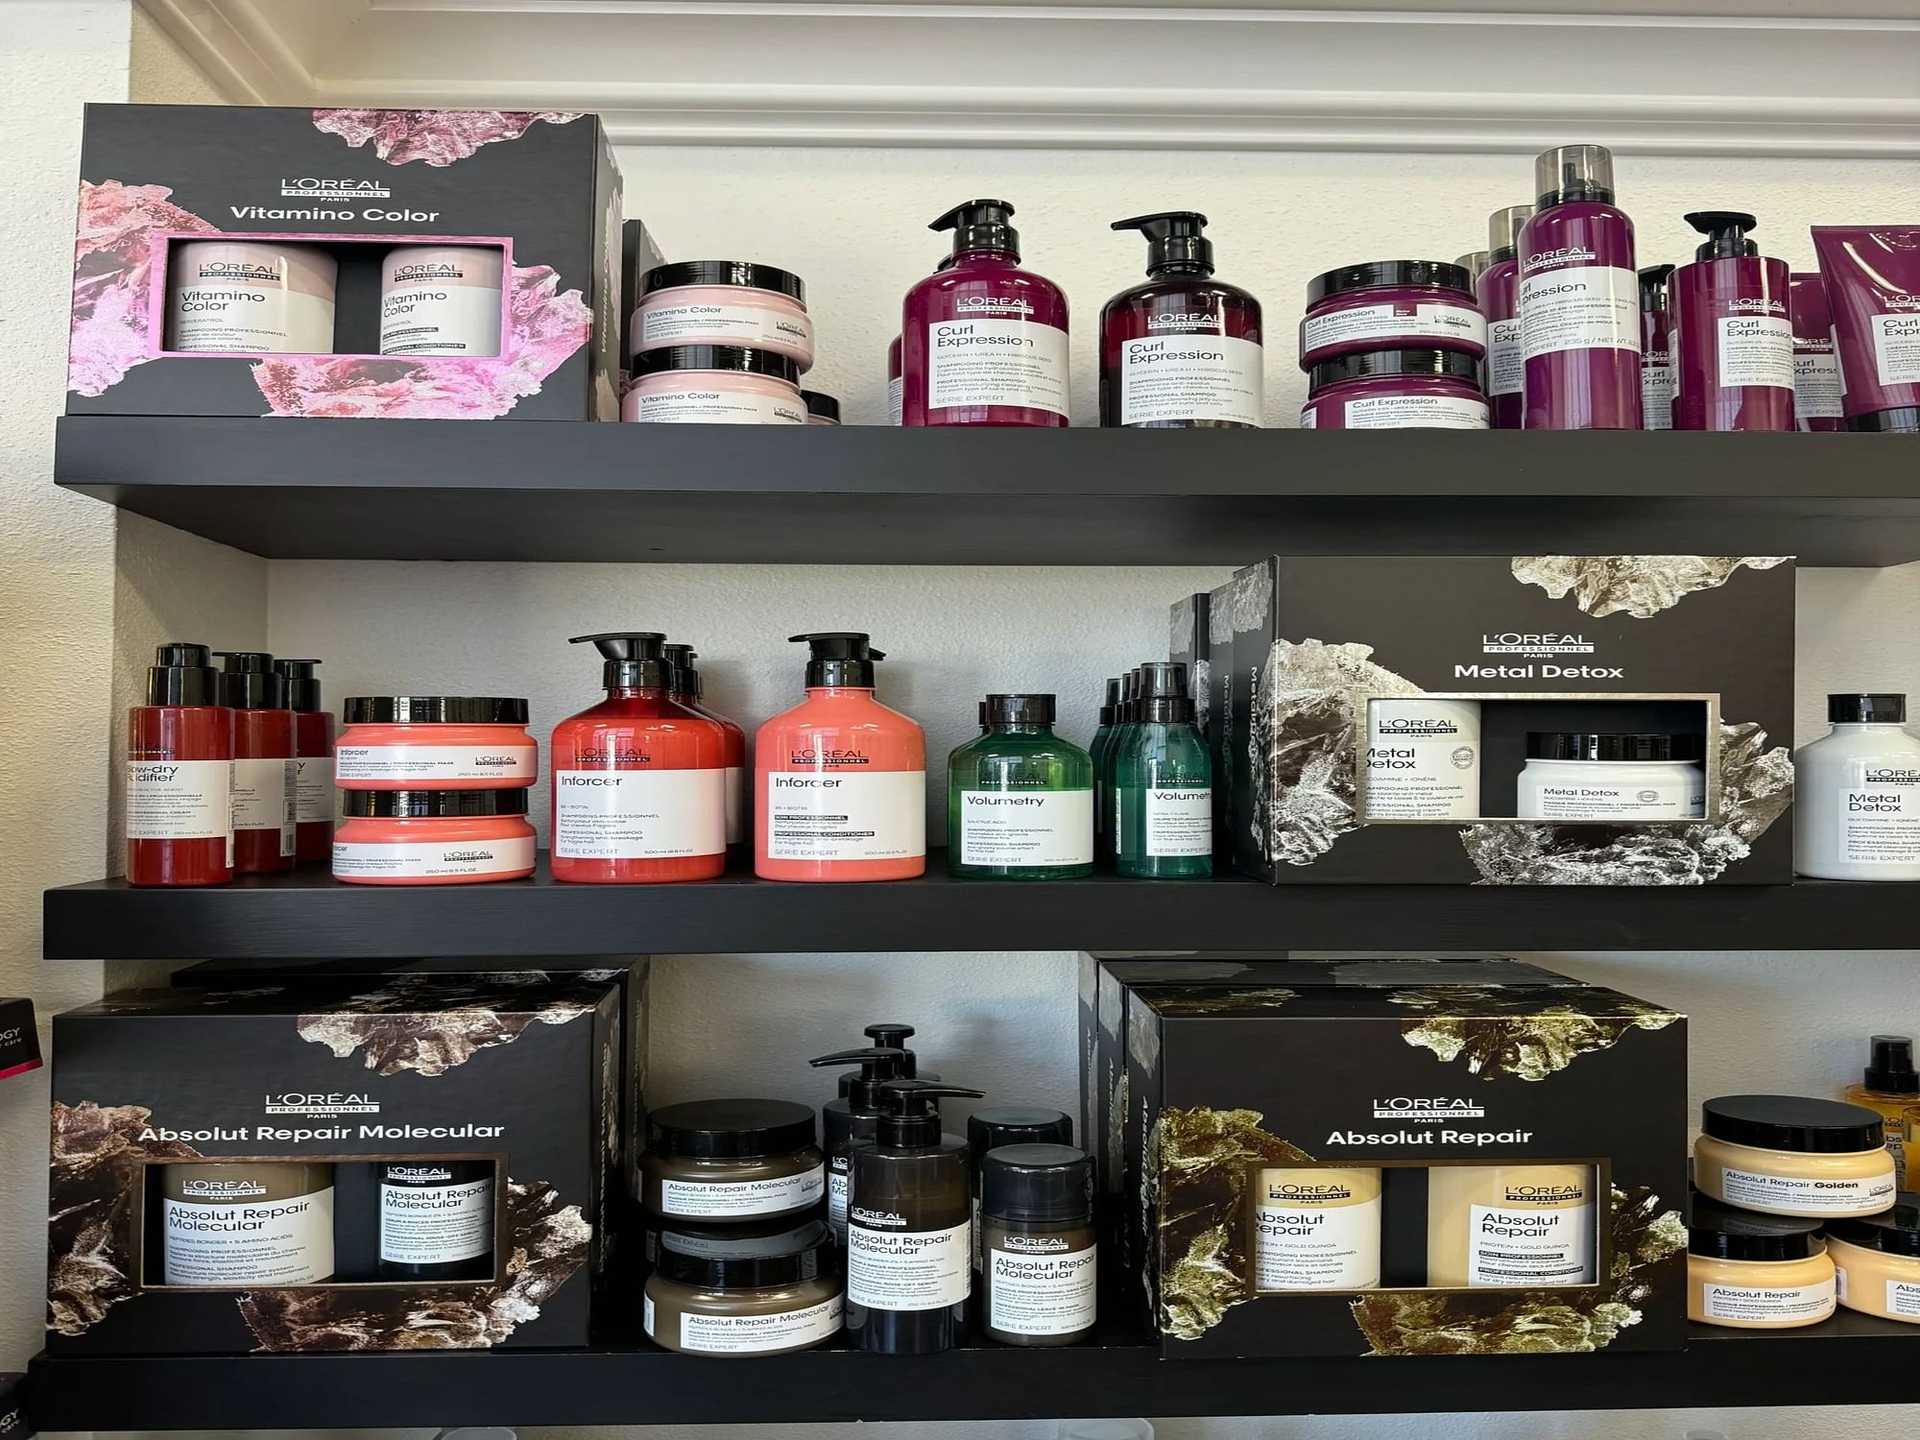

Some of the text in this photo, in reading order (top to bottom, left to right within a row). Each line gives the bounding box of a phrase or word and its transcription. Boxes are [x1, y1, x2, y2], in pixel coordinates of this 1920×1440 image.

[281, 177, 390, 190] L'ORÉAL
[231, 206, 439, 222] Vitamino Color
[182, 291, 265, 302] Vitamino
[384, 291, 447, 307] Vitamino
[181, 302, 229, 312] Color
[384, 304, 415, 318] Color
[647, 307, 687, 319] Vitamino
[1322, 310, 1376, 324] Expression
[1727, 320, 1759, 329] Curl
[1883, 320, 1918, 329] Curl
[937, 325, 974, 337] Curl
[937, 336, 1034, 348] Expression
[1130, 342, 1164, 352] Curl
[1130, 350, 1223, 364] Expression
[641, 392, 720, 404] Vitamino Color
[1352, 400, 1376, 409] Curl
[1484, 632, 1594, 645] L'ORÉAL
[1454, 664, 1624, 678] Metal Detox
[561, 776, 622, 786] Inforcer
[776, 778, 842, 788] Inforcer
[1581, 789, 1620, 797] Detox
[1849, 794, 1900, 802] Metal
[968, 796, 1044, 807] Volumetry
[1849, 802, 1901, 812] Detox
[266, 1092, 380, 1105] L'ORÉAL
[1374, 1097, 1484, 1110] L'ORÉAL
[1374, 1110, 1484, 1118] PROFESSIONNEL
[138, 1124, 504, 1143] Absolut Repair Molecular
[1326, 1130, 1533, 1146] Absolut Repair
[668, 1178, 801, 1193] Absolut Repair Molecular
[1727, 1172, 1766, 1184] Absolut
[1770, 1179, 1810, 1188] Repair
[386, 1190, 441, 1200] Absolut
[386, 1199, 463, 1209] Molecular
[170, 1202, 310, 1220] Absolut Repair
[170, 1218, 265, 1232] Molecular
[1482, 1214, 1560, 1226] Absolut
[1482, 1224, 1550, 1238] Repair
[850, 1230, 952, 1246] Absolut Repair
[850, 1238, 920, 1254] Molecular
[996, 1258, 1054, 1270] Absolut
[996, 1267, 1074, 1280] Molecular
[1713, 1288, 1761, 1298] Absolut
[688, 1306, 830, 1327] Absolut Repair Molecular
